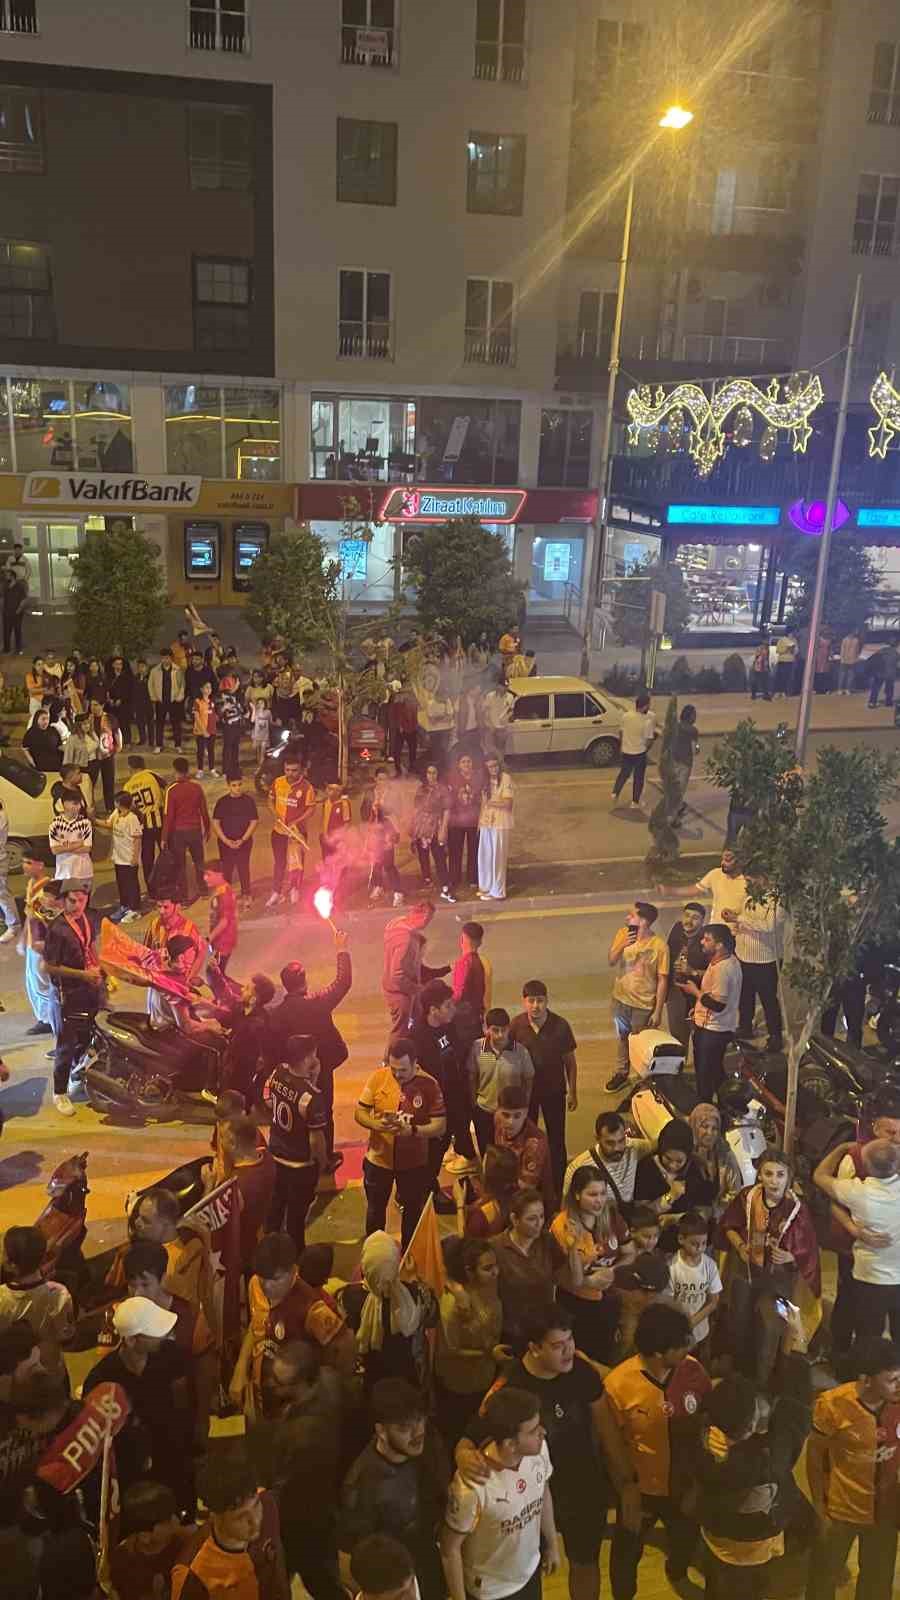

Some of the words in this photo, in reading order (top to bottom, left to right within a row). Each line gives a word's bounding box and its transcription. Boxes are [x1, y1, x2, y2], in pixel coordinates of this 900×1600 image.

[421, 496, 461, 514] Ziraat
[271, 1078, 298, 1104] MESSI
[271, 1092, 294, 1132] 10
